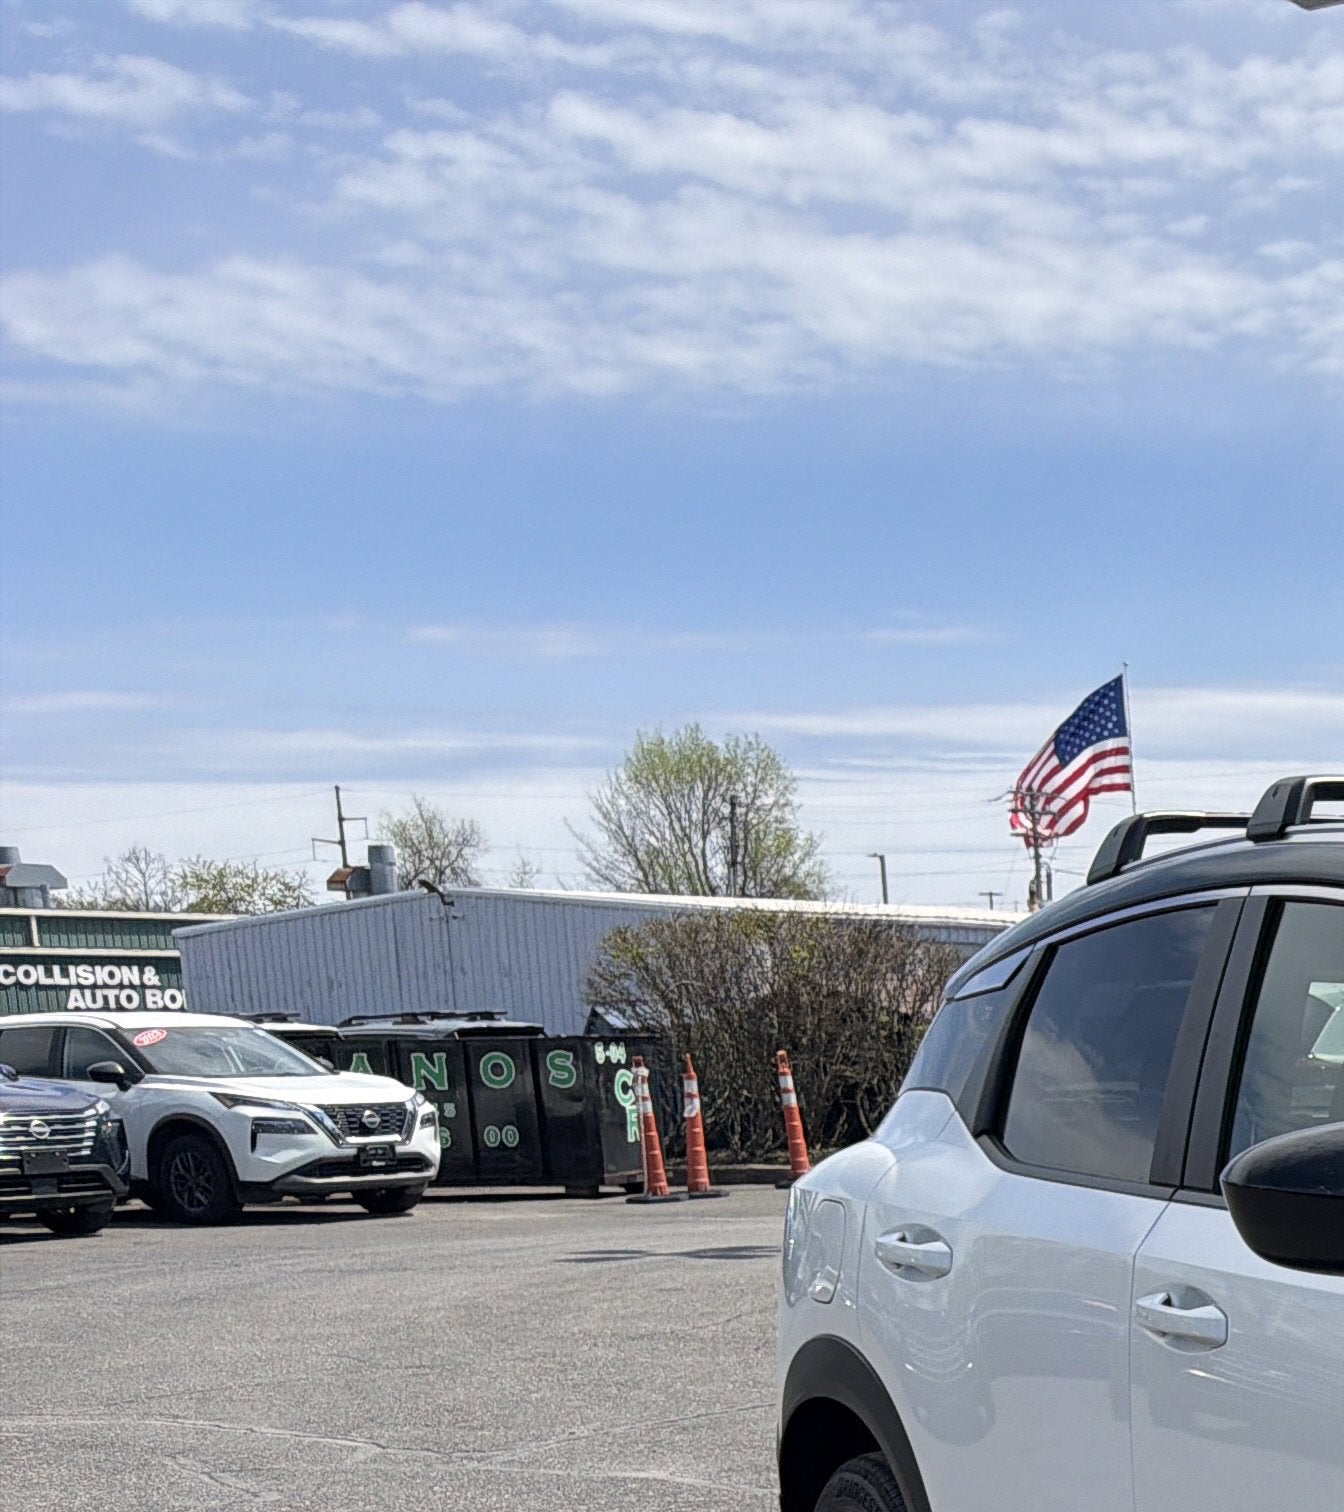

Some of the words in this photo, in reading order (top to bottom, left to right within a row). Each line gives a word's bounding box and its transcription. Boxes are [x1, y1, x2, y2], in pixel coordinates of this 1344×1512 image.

[0, 964, 141, 986] COLLISION
[143, 966, 161, 986] &
[67, 989, 140, 1010] AUTO
[146, 989, 188, 1010] BO
